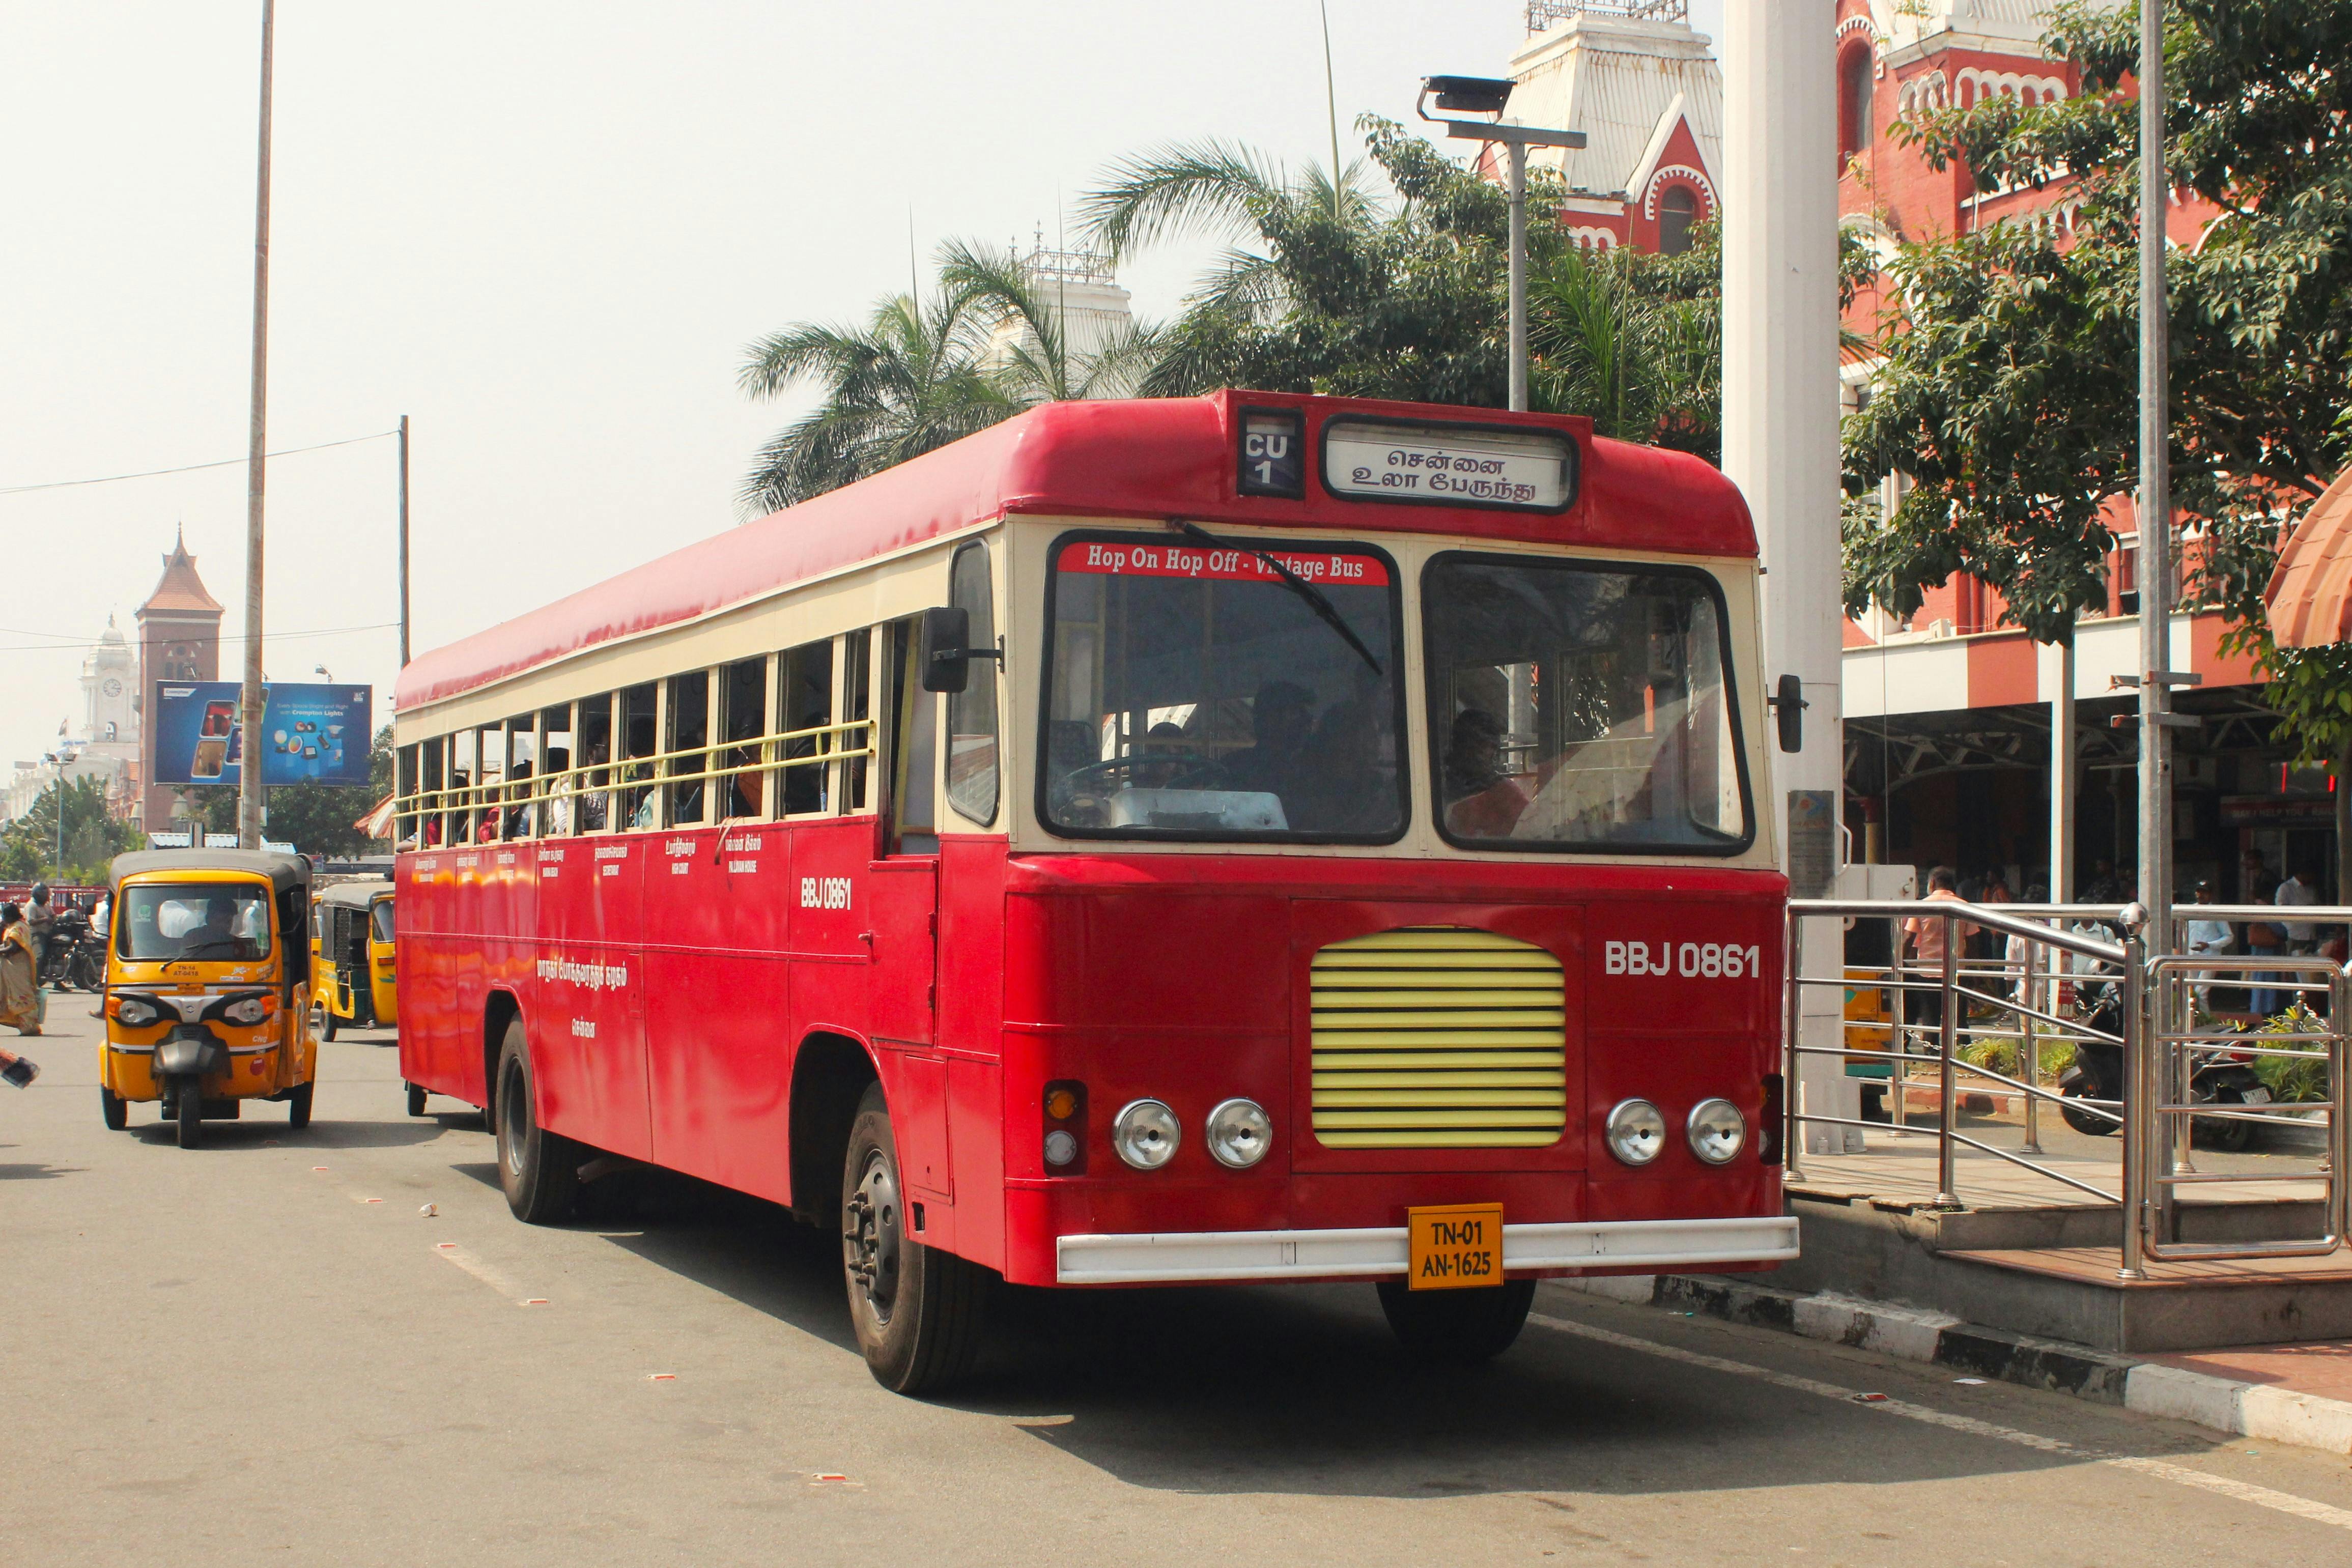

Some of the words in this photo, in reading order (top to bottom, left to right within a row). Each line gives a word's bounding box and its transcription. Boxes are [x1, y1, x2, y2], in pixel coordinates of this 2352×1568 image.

[1245, 433, 1288, 459] CU
[1255, 461, 1271, 484] 1
[1387, 450, 1506, 475] சென்னை
[1352, 467, 1420, 489] உலா
[1429, 473, 1536, 503] பேருந்து
[1087, 545, 1125, 573] Hop
[1131, 547, 1158, 568] On
[1166, 549, 1203, 576] Hop
[1209, 551, 1239, 572] Off
[1329, 557, 1364, 578] Bus
[2285, 808, 2304, 816] YOU
[678, 862, 689, 874] COURT
[728, 861, 745, 873] PALLAVAN
[745, 860, 757, 873] HOUSE
[801, 877, 823, 908] BBJ
[824, 877, 851, 910] 0861
[1605, 940, 1670, 976] BBJ
[1679, 942, 1760, 978] 0861
[537, 955, 558, 984] மாநகர்
[606, 960, 627, 992] கழகம்
[572, 1015, 596, 1039] சென்னை
[1431, 1220, 1482, 1245] TN-01
[1422, 1251, 1491, 1277] AN-1625
